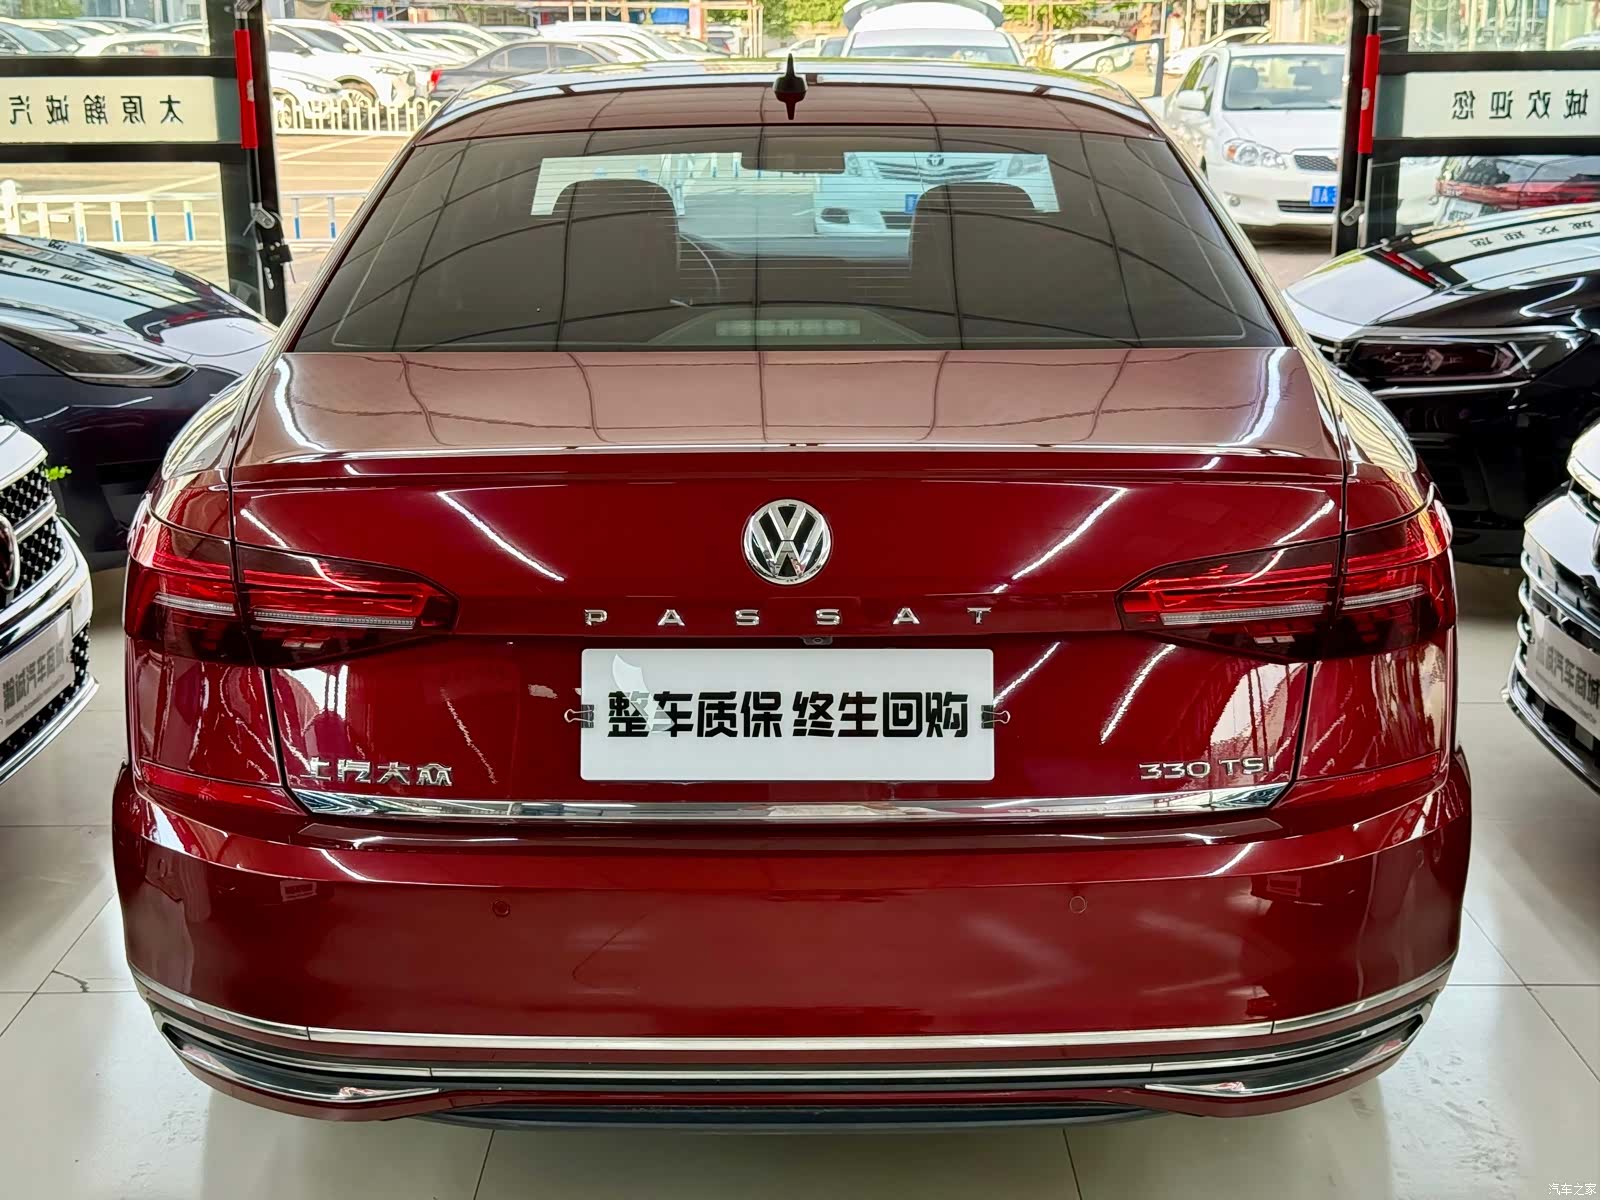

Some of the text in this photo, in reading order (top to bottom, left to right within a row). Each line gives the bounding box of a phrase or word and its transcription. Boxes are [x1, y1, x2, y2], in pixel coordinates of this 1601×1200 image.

[584, 607, 992, 627] PASSAT
[607, 691, 968, 738] 整车质保 终生回购
[300, 756, 452, 786] 上汽大众
[1139, 755, 1275, 781] 330 TSI
